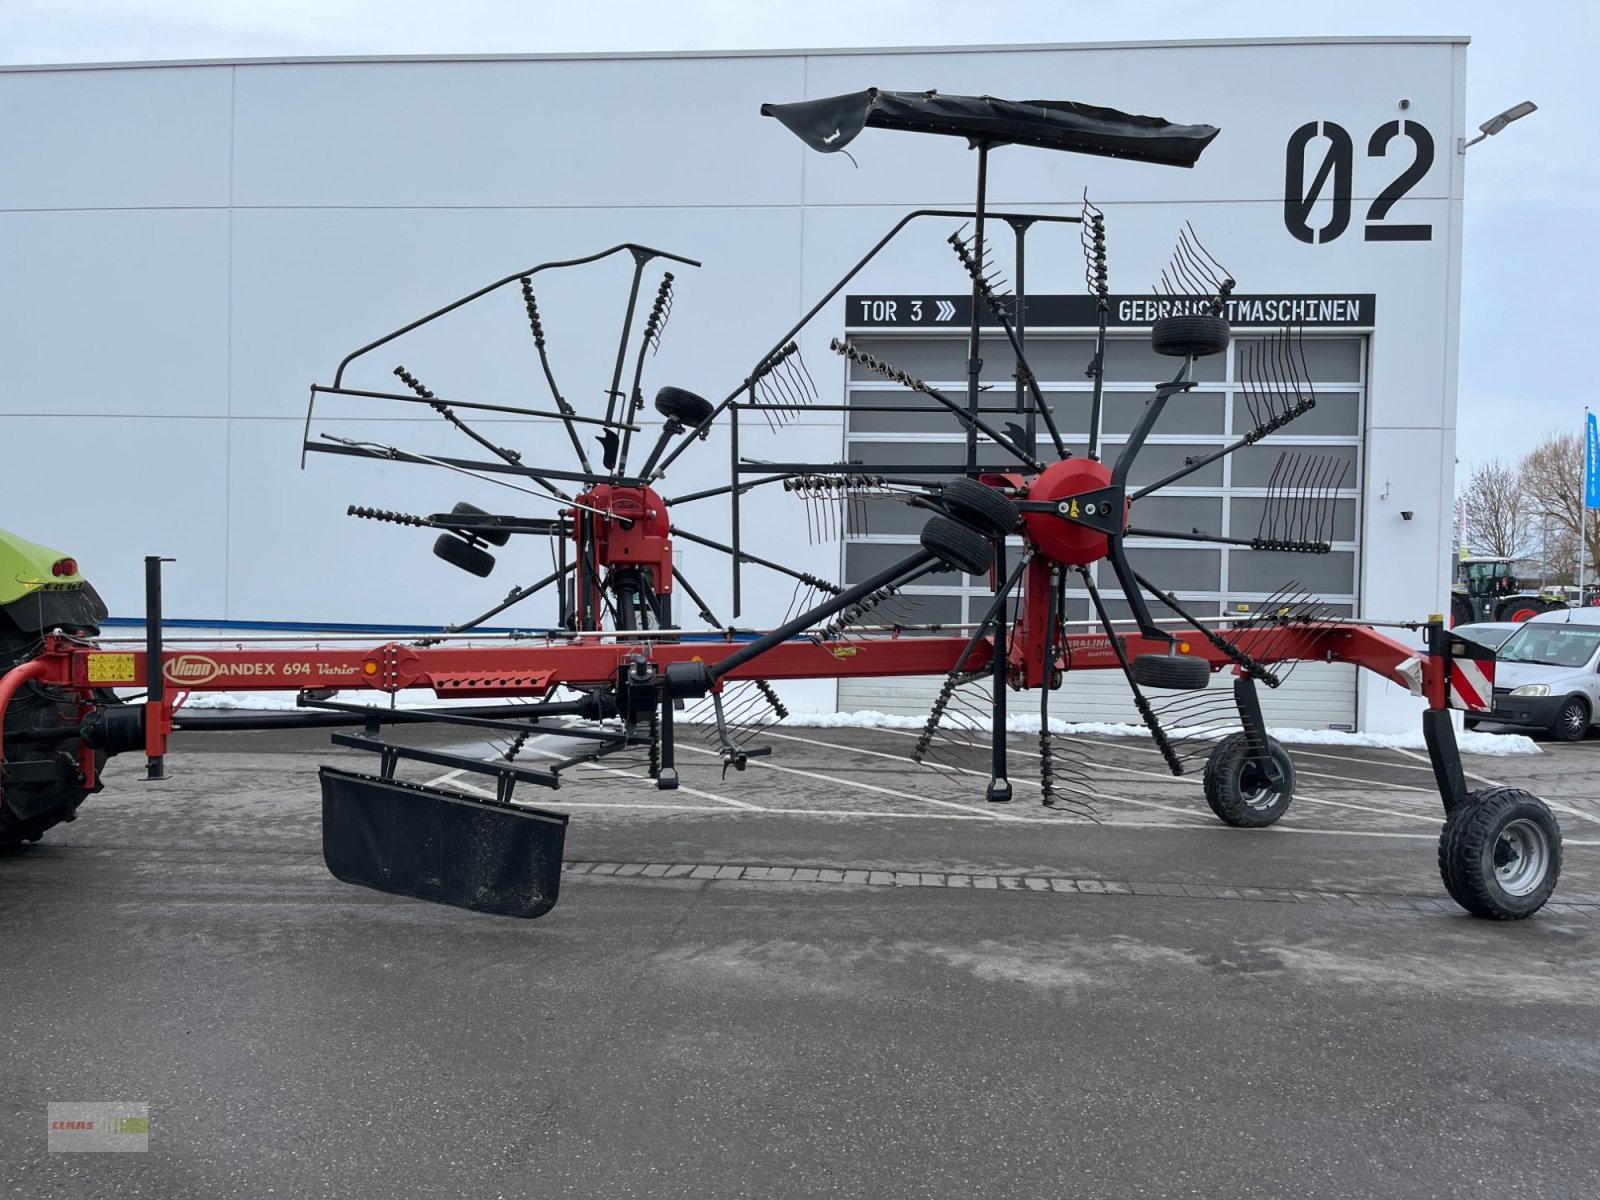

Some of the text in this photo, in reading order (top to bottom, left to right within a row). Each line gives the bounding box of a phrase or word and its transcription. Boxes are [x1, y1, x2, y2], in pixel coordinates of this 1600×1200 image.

[1284, 120, 1435, 244] 02
[860, 300, 923, 321] TOR 3
[1119, 299, 1360, 321] GEBRAUCTMASCHINEN
[166, 655, 360, 678] Vicon ANDEX 694 Vario
